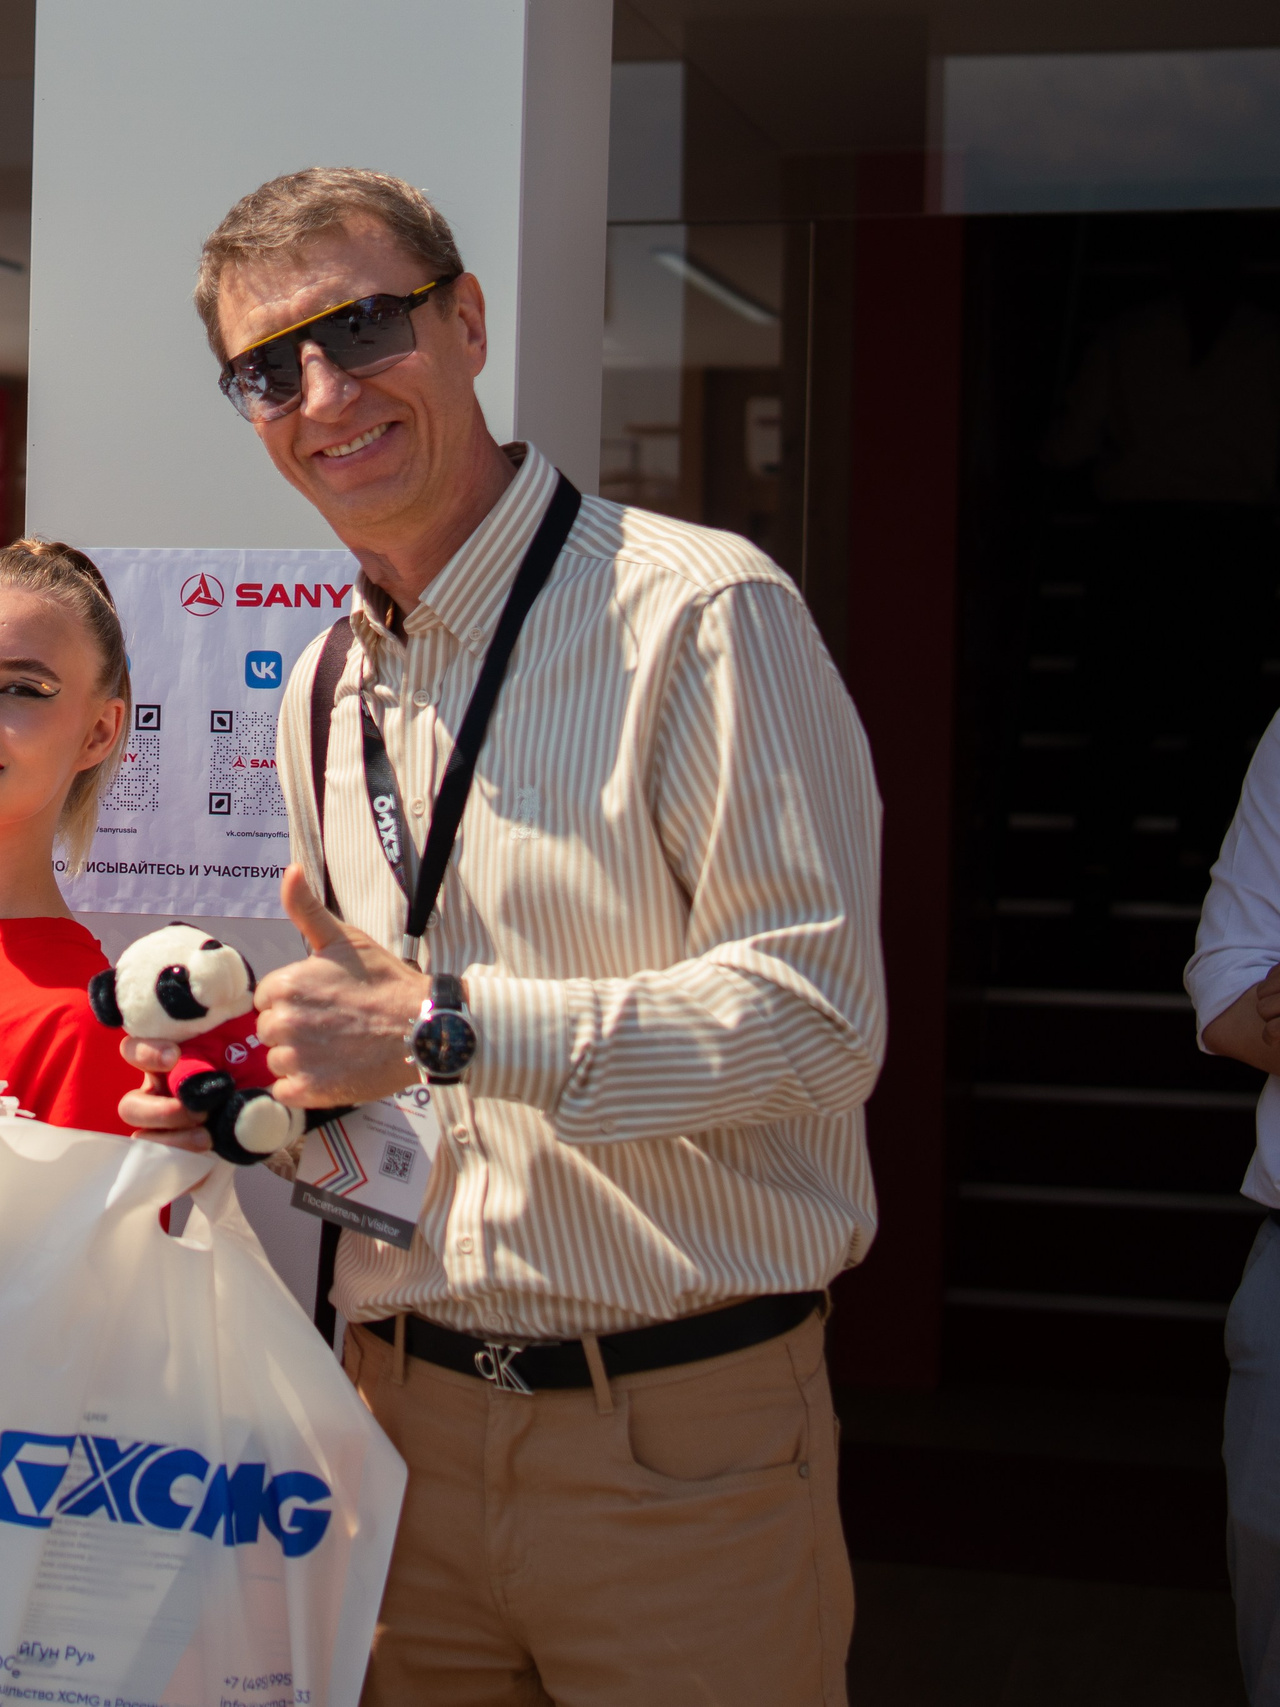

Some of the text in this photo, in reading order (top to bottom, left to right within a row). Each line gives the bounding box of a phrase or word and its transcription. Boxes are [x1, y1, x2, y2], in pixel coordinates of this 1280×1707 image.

[236, 582, 353, 608] SANY
[250, 661, 277, 679] VK
[251, 758, 277, 769] SAN
[96, 825, 137, 835] /sanyrussia
[226, 830, 290, 840] vk.com/sanyoffici
[52, 860, 287, 880] ОИСЫВАЙТЕСЬ И УЧАСТВУЙТ
[302, 1191, 360, 1222] Посетитель
[367, 1215, 401, 1238] Visitor
[57, 1434, 333, 1559] XCMG
